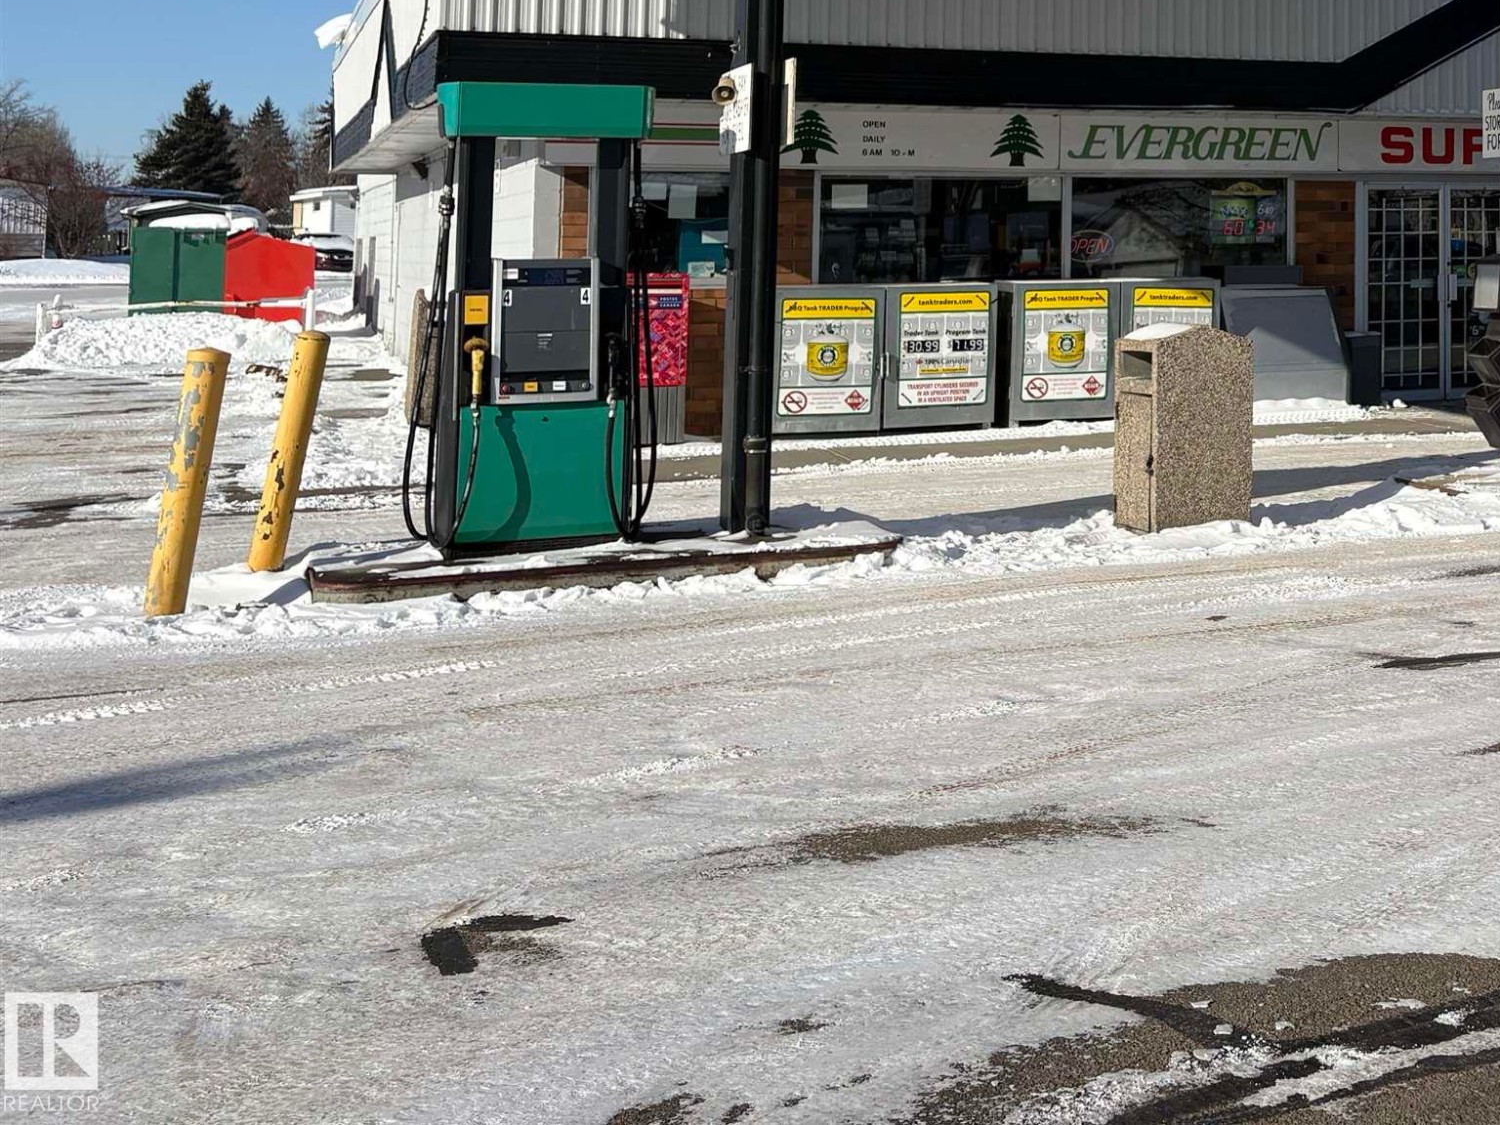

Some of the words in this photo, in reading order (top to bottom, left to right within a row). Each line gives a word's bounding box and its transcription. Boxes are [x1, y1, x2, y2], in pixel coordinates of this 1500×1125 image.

[862, 120, 886, 128] OPEN
[862, 135, 885, 143] DAILY
[1068, 122, 1332, 161] EVERGREEN
[503, 291, 510, 304] 4
[582, 290, 589, 302] 4
